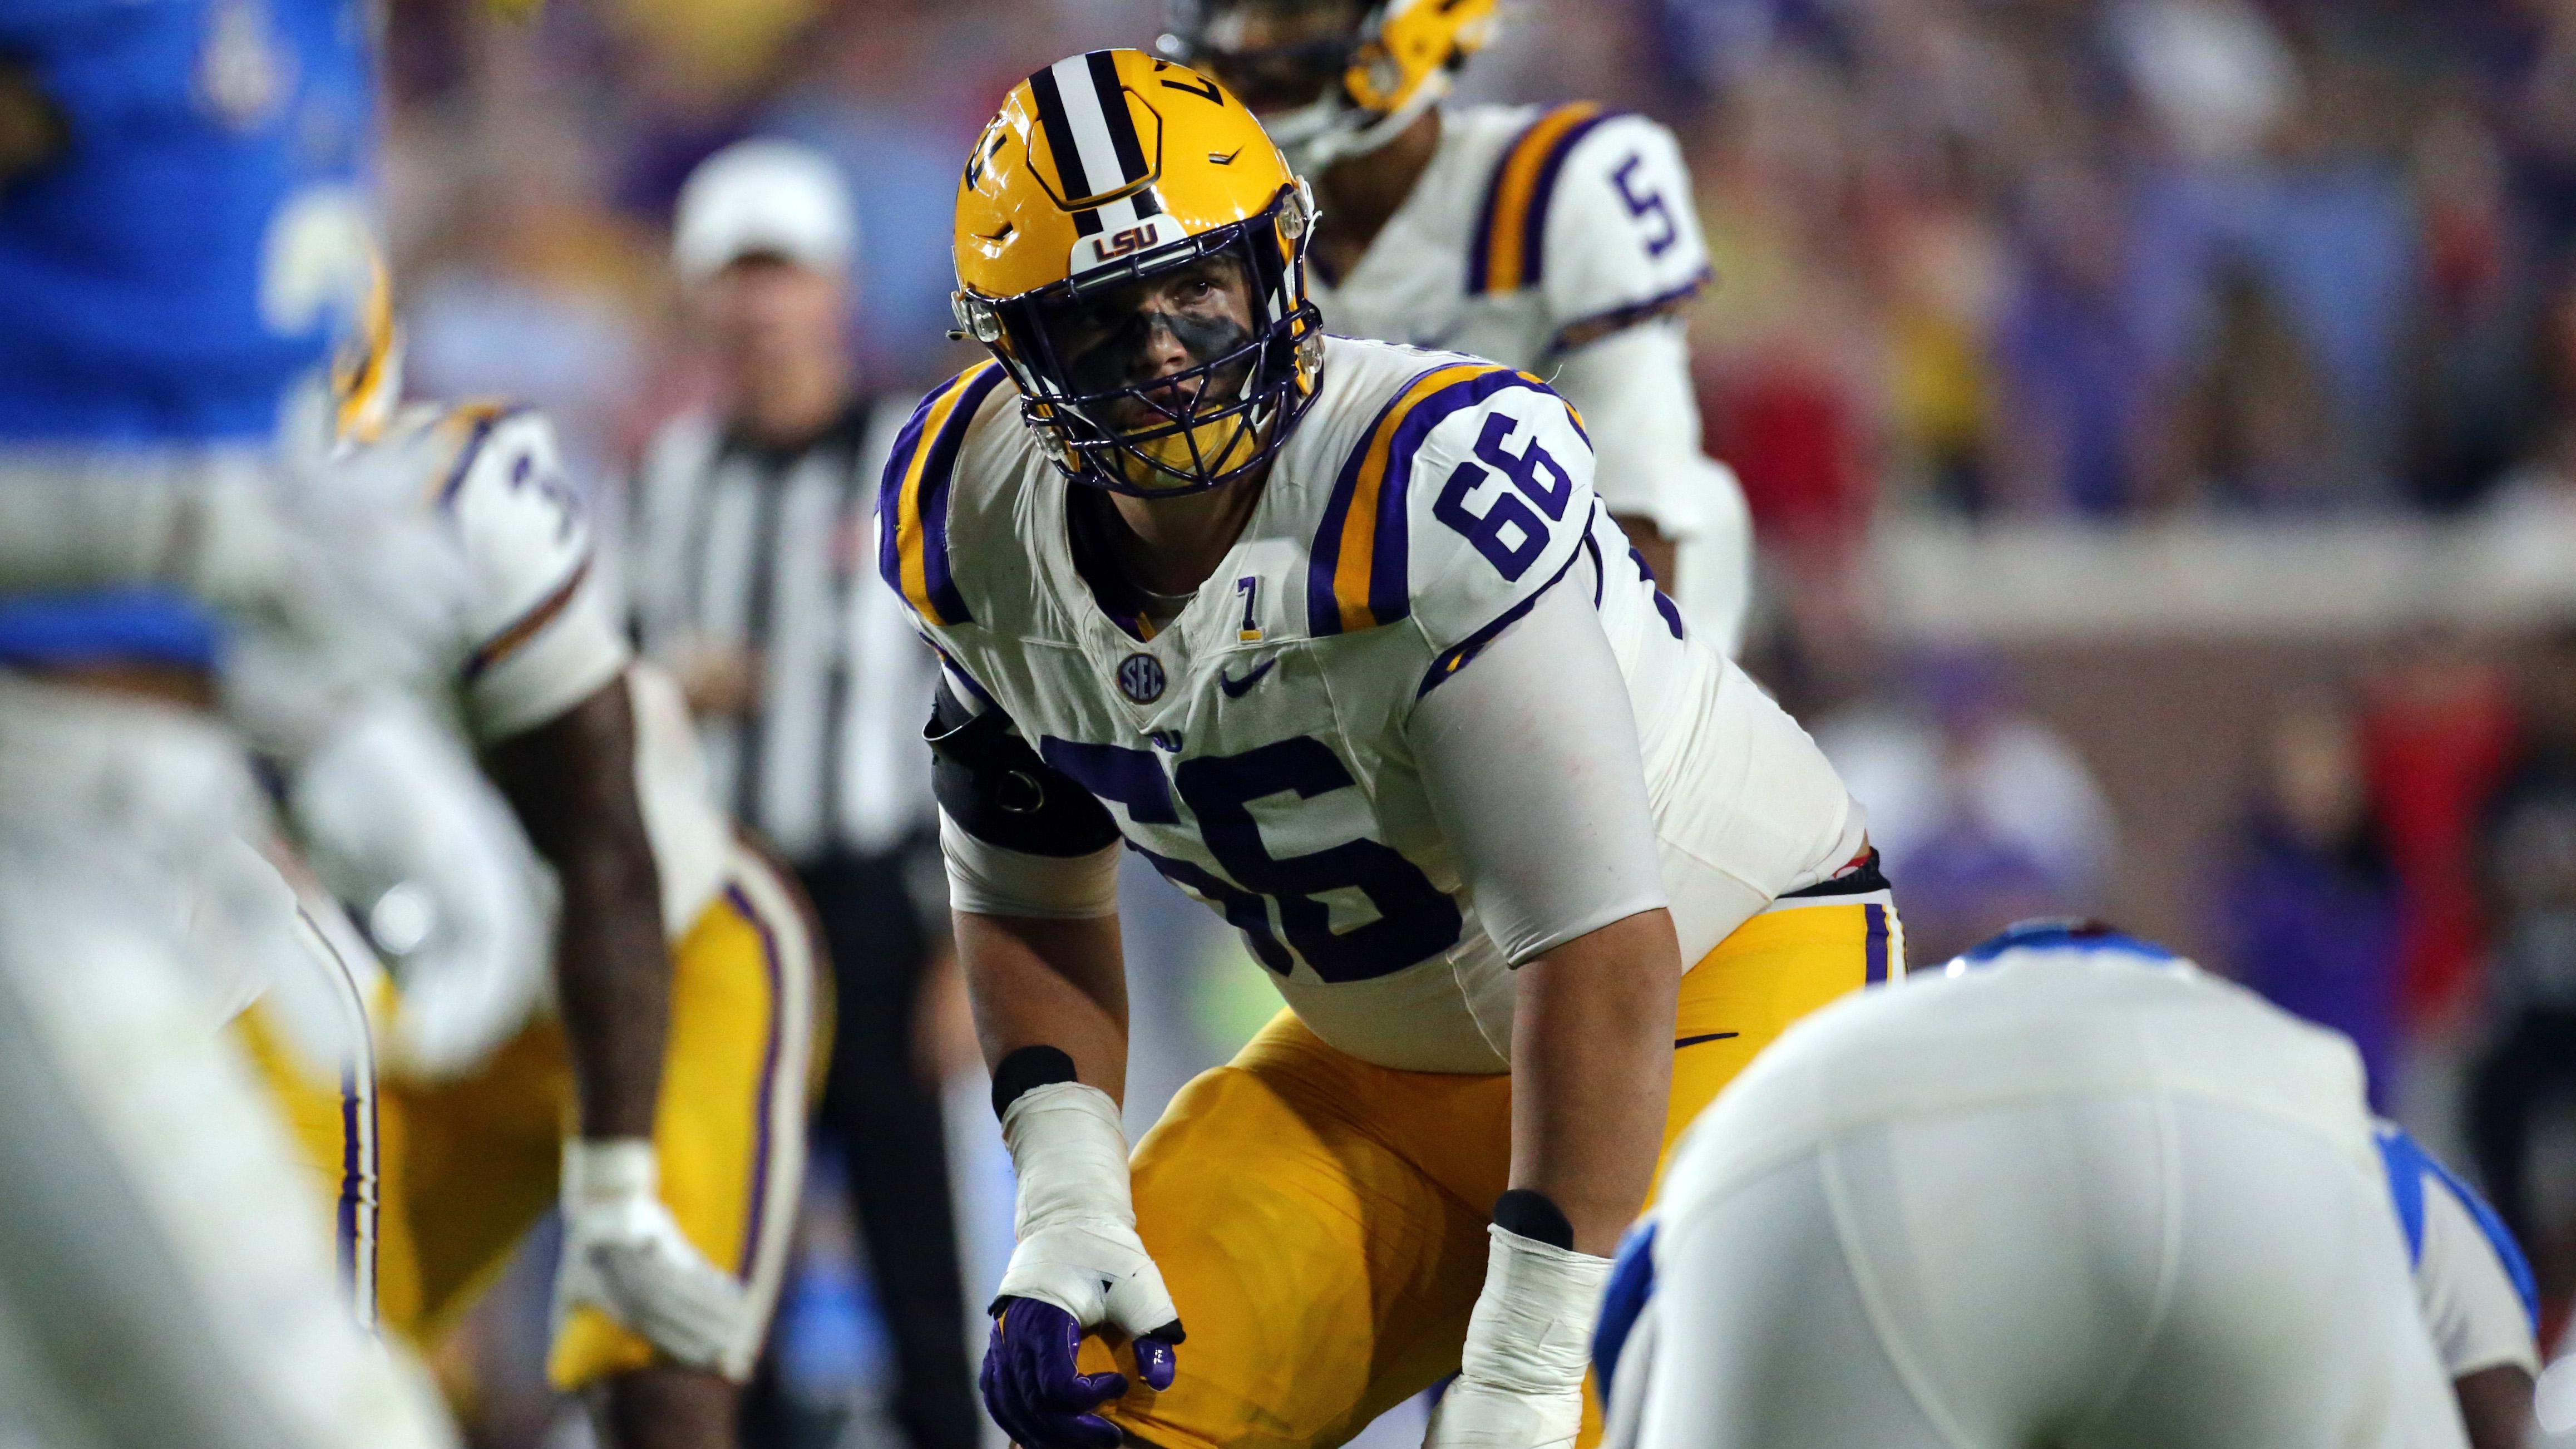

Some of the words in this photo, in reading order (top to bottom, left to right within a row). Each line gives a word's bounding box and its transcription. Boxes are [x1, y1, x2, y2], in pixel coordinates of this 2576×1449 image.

[1610, 152, 1676, 256] 5
[1092, 223, 1159, 263] LSU
[1432, 412, 1572, 583] 66
[1237, 576, 1262, 641] 7
[1121, 657, 1163, 701] SEC
